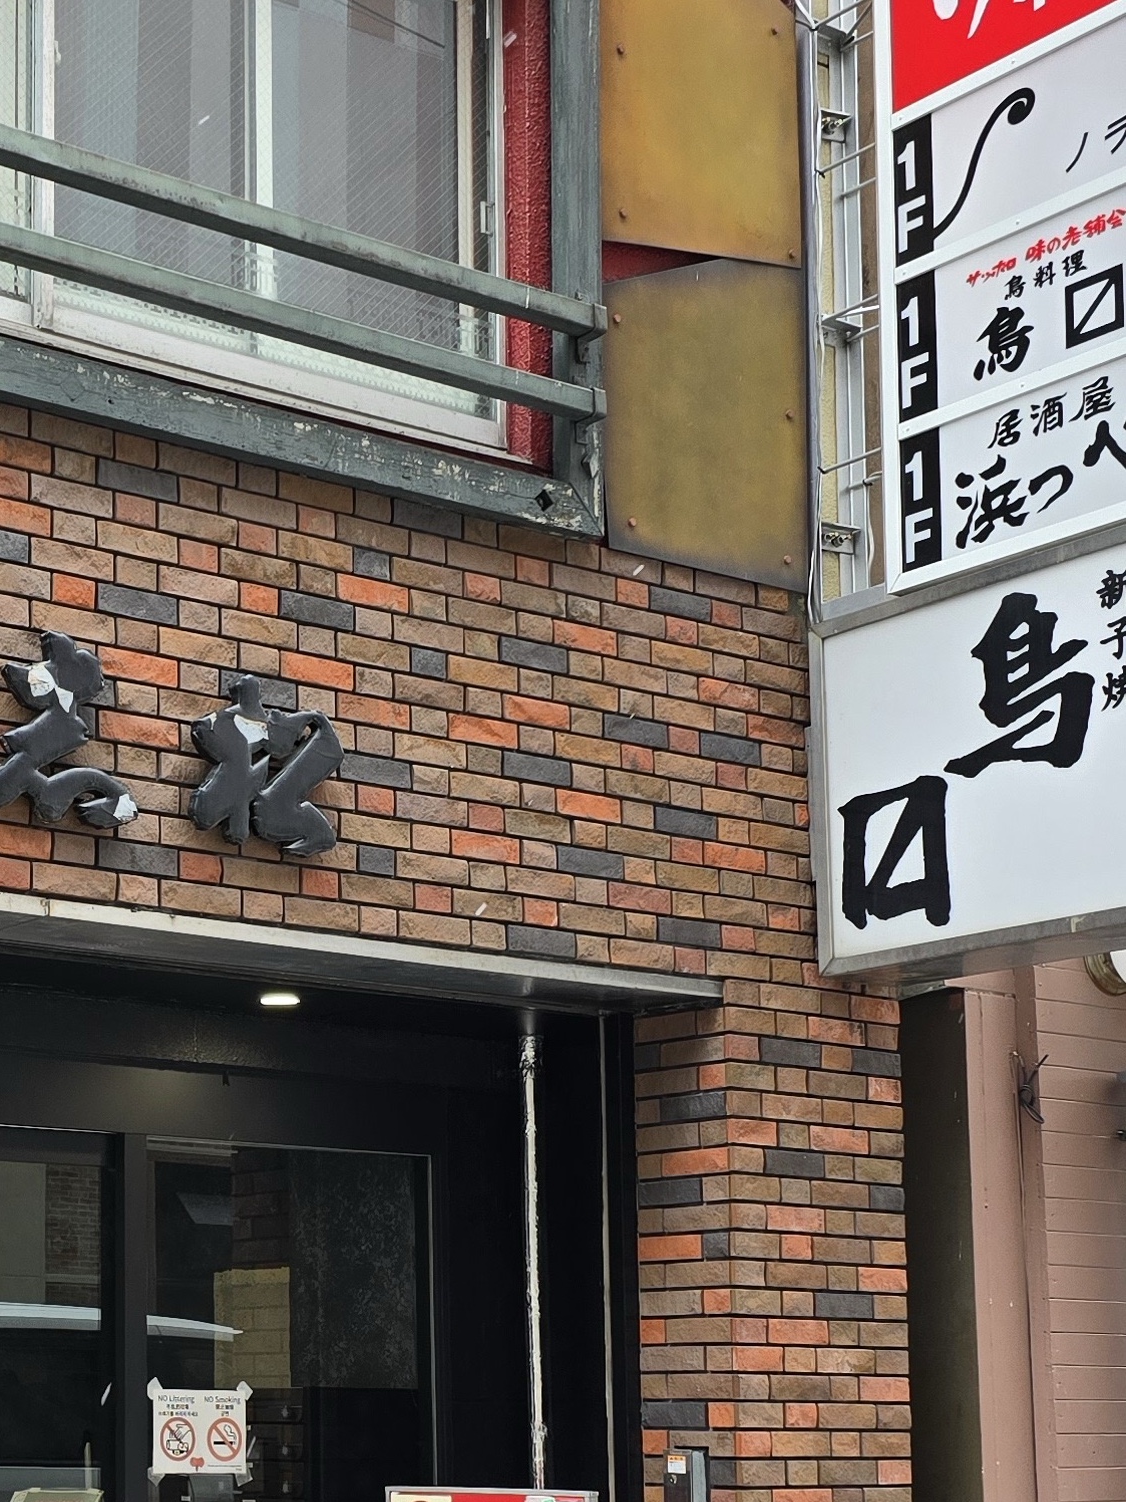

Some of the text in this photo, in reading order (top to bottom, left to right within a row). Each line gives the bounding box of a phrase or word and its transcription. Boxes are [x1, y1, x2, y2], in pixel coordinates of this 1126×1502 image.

[1004, 250, 1087, 300] 鳥料理
[987, 376, 1116, 449] 居酒屋
[215, 1396, 241, 1404] Smoking
